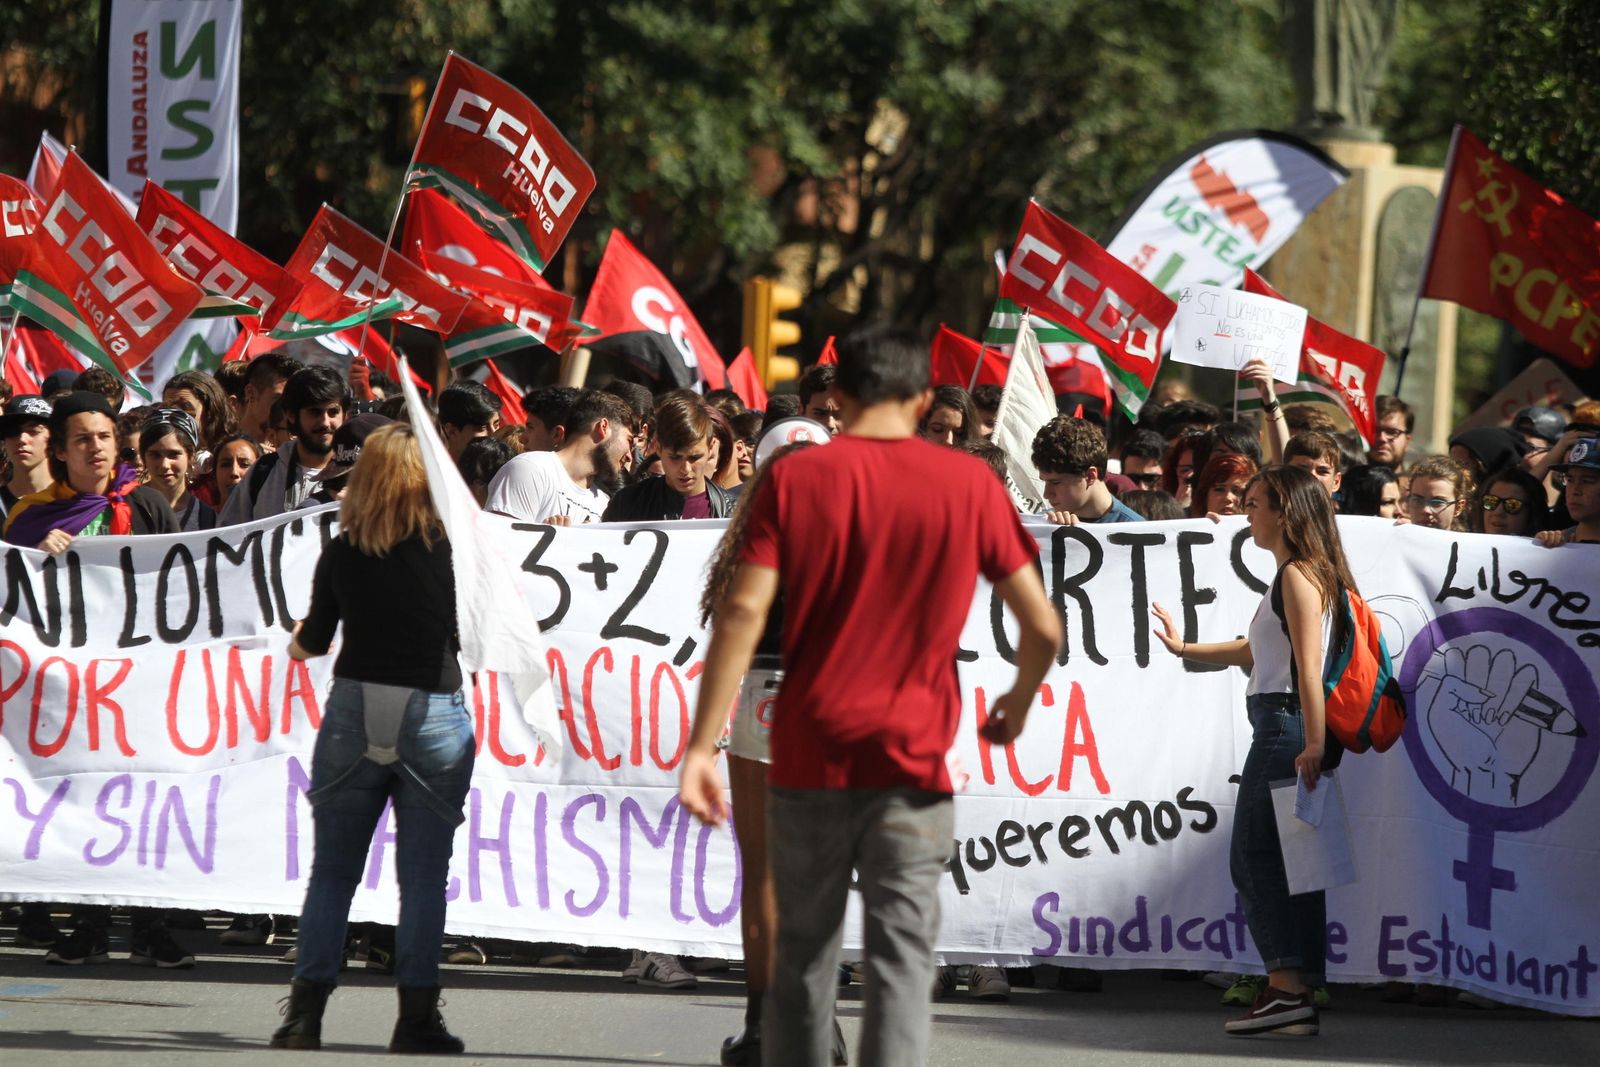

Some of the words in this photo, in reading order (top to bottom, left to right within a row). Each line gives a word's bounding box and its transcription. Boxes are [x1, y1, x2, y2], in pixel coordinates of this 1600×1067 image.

[127, 31, 148, 178] ANDALUZA
[444, 92, 577, 218] CCOO
[502, 161, 555, 235] Huelva
[42, 189, 173, 337] CCOO
[73, 281, 130, 356] Huelva
[1007, 233, 1160, 364] CCOO
[1195, 291, 1221, 317] SI
[0, 548, 87, 648] NI
[118, 511, 334, 648] LOMC
[511, 523, 697, 667] 3+2,
[0, 639, 137, 758] POR
[165, 645, 322, 757] UNA
[3, 777, 71, 860] Y
[83, 774, 221, 874] SIN
